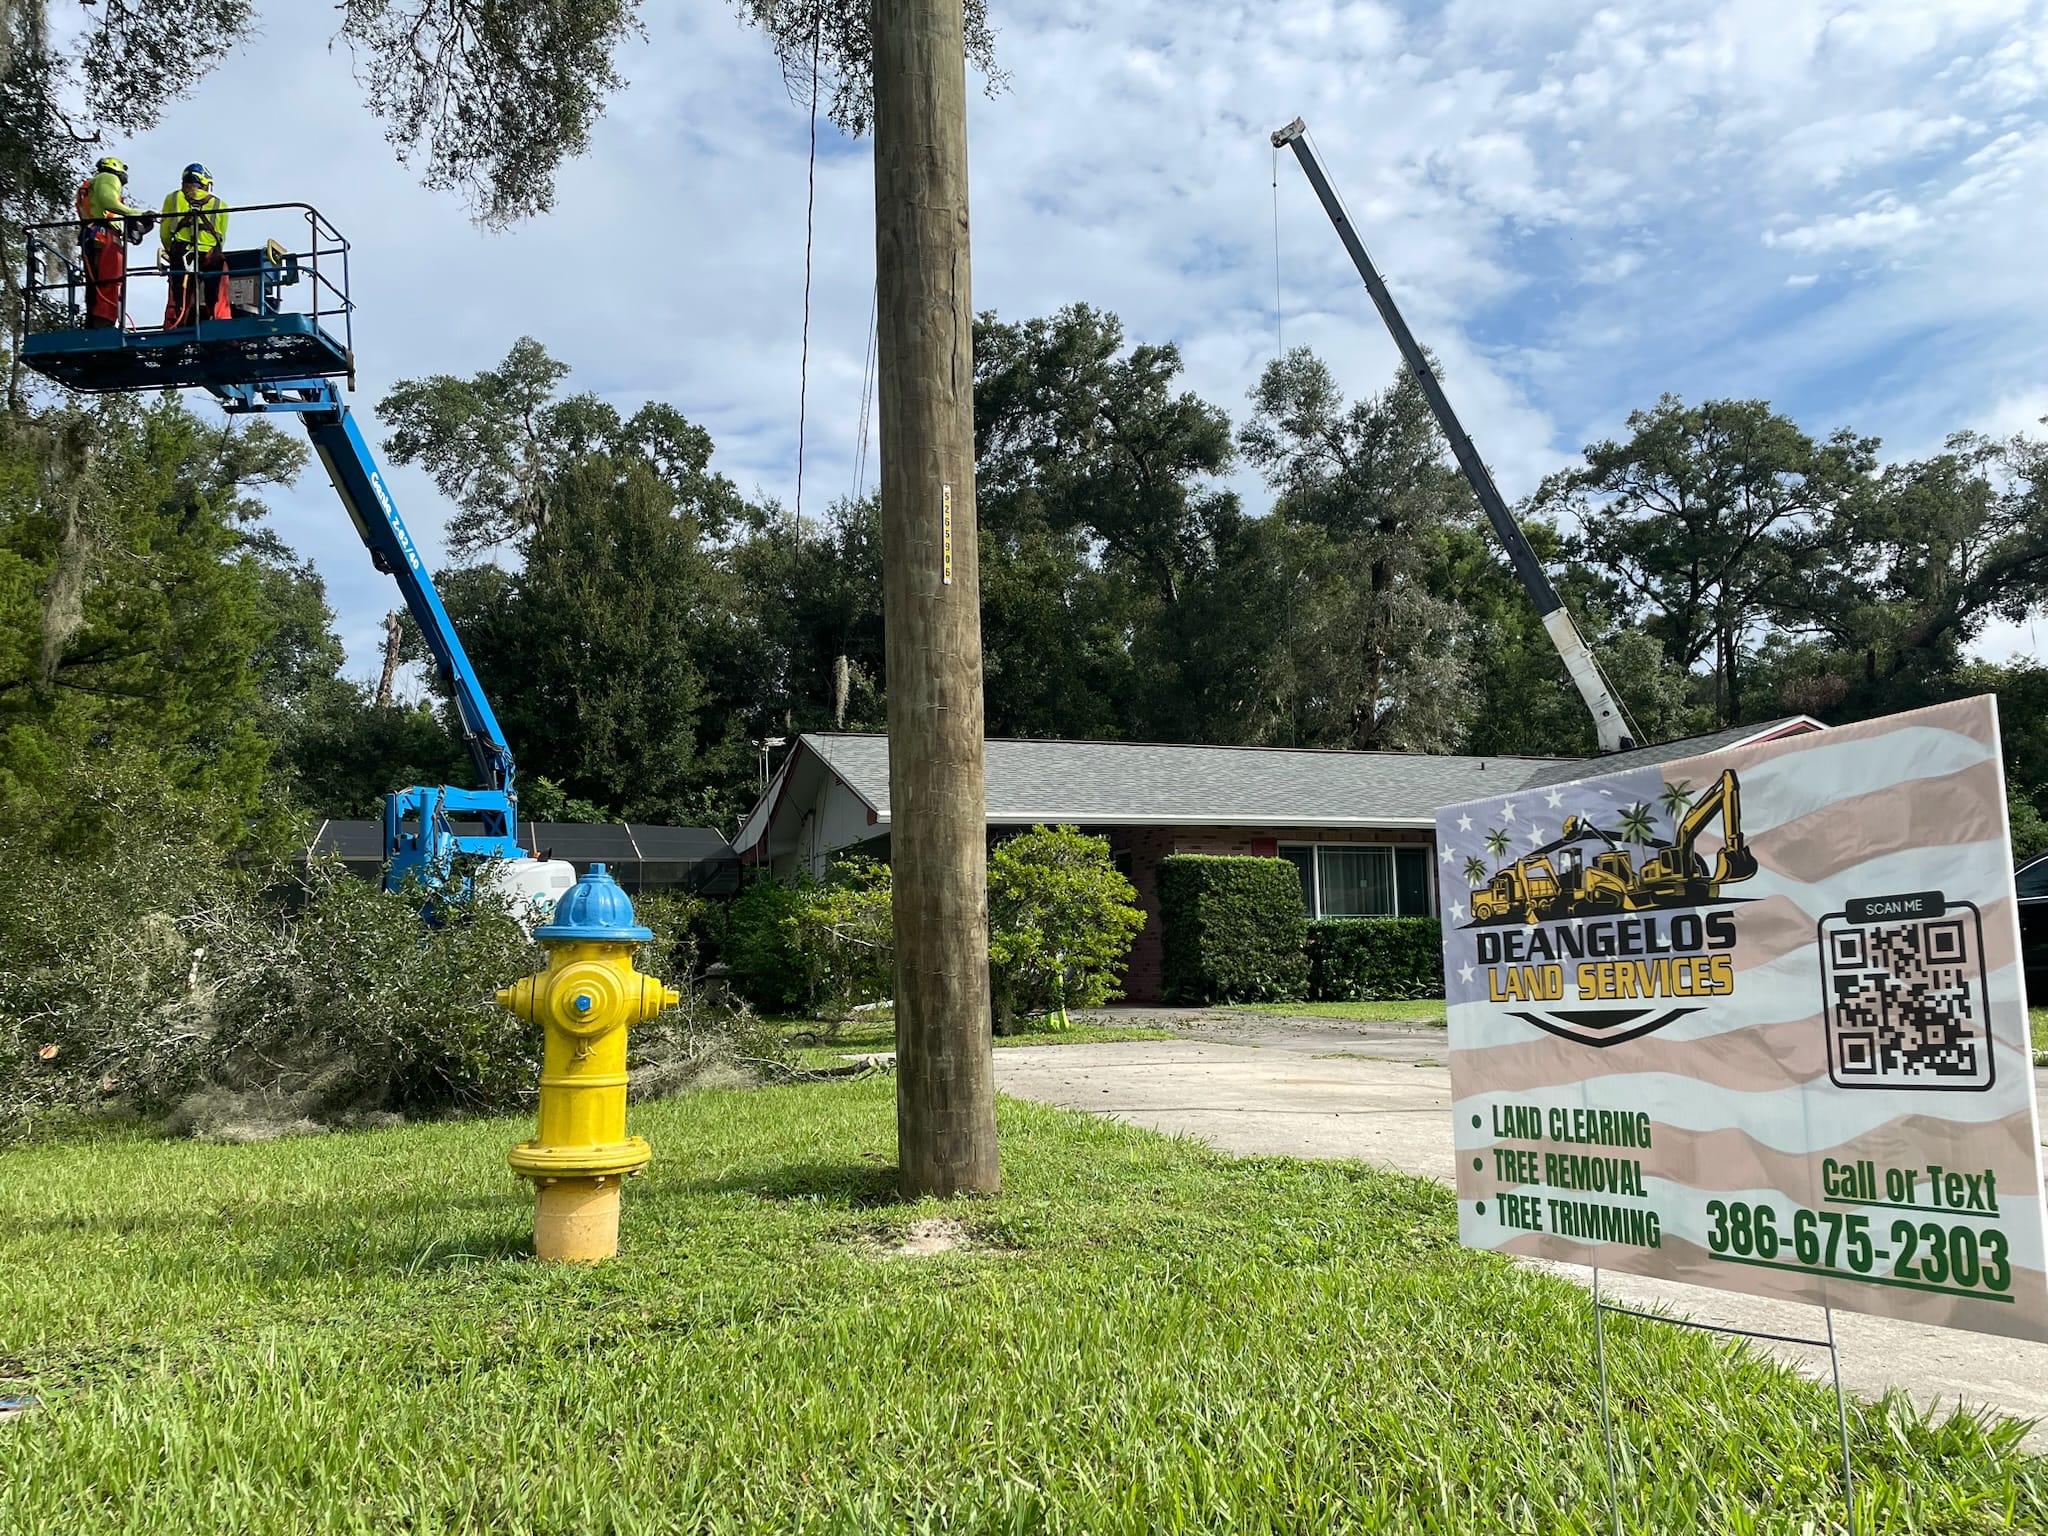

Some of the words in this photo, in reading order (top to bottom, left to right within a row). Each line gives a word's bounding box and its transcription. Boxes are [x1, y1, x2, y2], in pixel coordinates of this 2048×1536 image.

[1865, 901, 1902, 916] SCAN
[1904, 899, 1923, 913] ME
[1476, 910, 1737, 965] DEANGELOS
[1488, 963, 1564, 1003] LAND
[1577, 954, 1734, 1001] SERVICES
[1492, 1104, 1543, 1141] LAND
[1548, 1106, 1652, 1149] CLEARING
[1493, 1148, 1540, 1186] TREE
[1544, 1152, 1648, 1198] REMOVAL
[1822, 1157, 1877, 1200] Call
[1885, 1167, 1918, 1204] or
[1926, 1165, 1999, 1212] Text
[1496, 1192, 1543, 1232] TREE
[1547, 1198, 1661, 1249] TRIMMING
[1706, 1200, 2012, 1292] 386-675-2303
